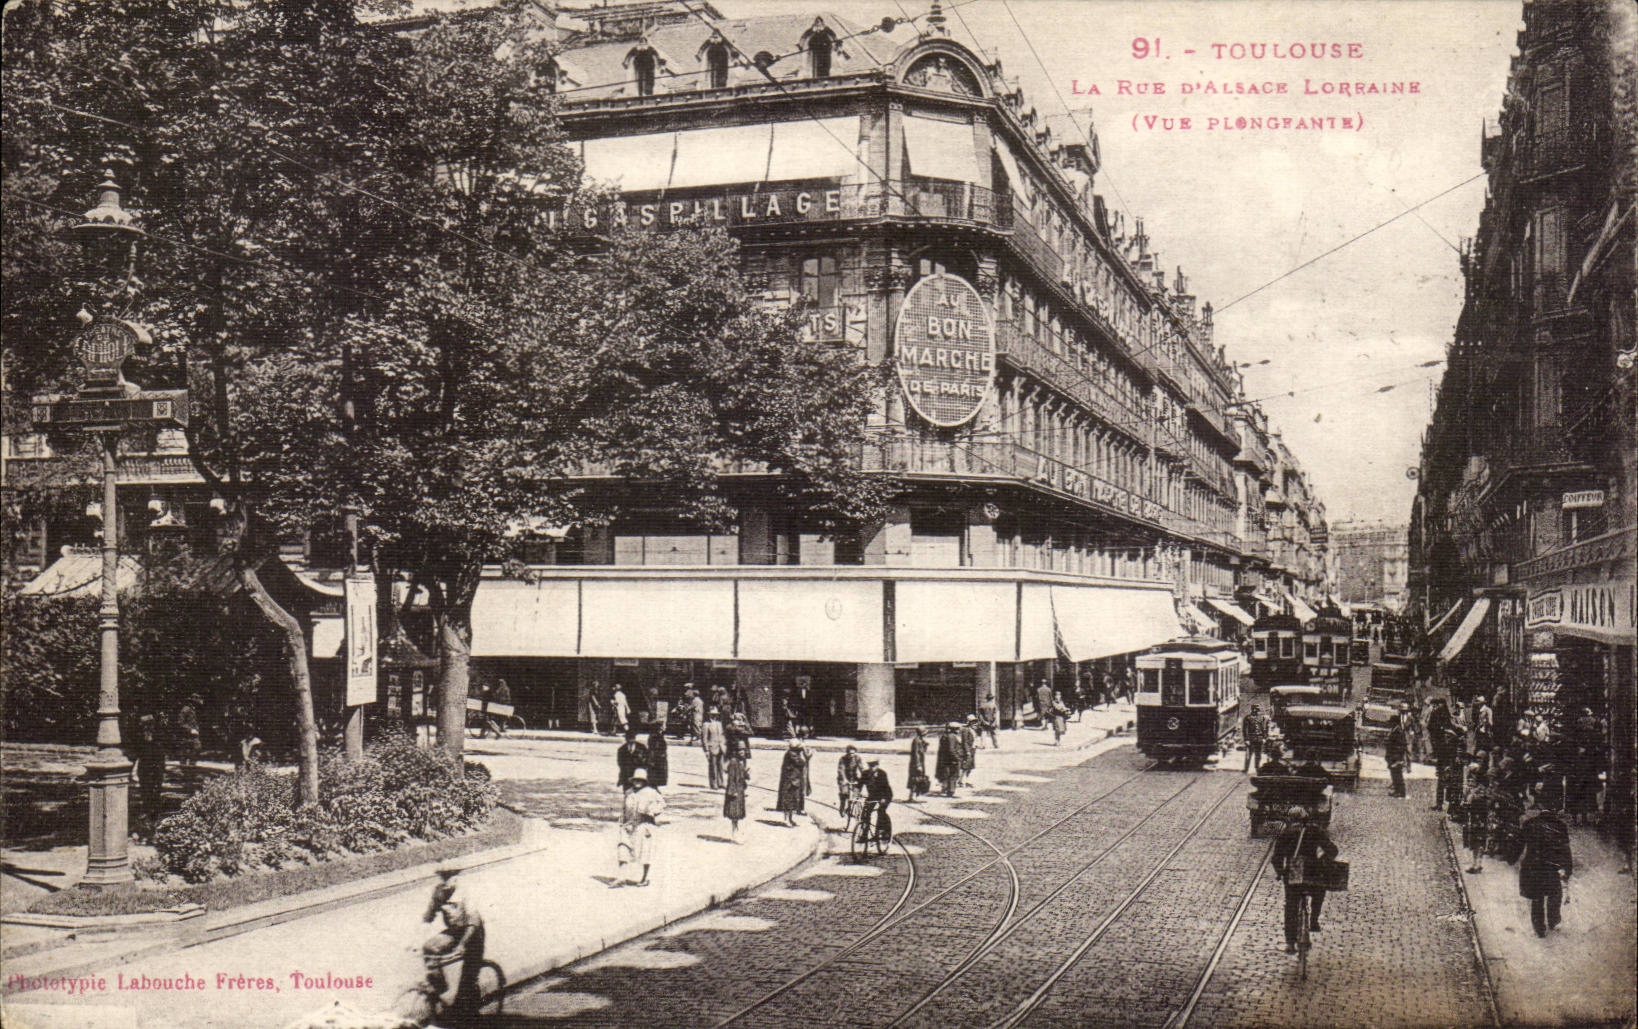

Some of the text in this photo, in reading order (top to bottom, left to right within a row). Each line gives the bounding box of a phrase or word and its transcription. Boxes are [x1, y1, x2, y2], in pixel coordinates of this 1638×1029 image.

[936, 294, 960, 307] AU
[928, 316, 971, 339] BON
[910, 380, 985, 397] DE PARIS
[1571, 587, 1615, 628] MAISON
